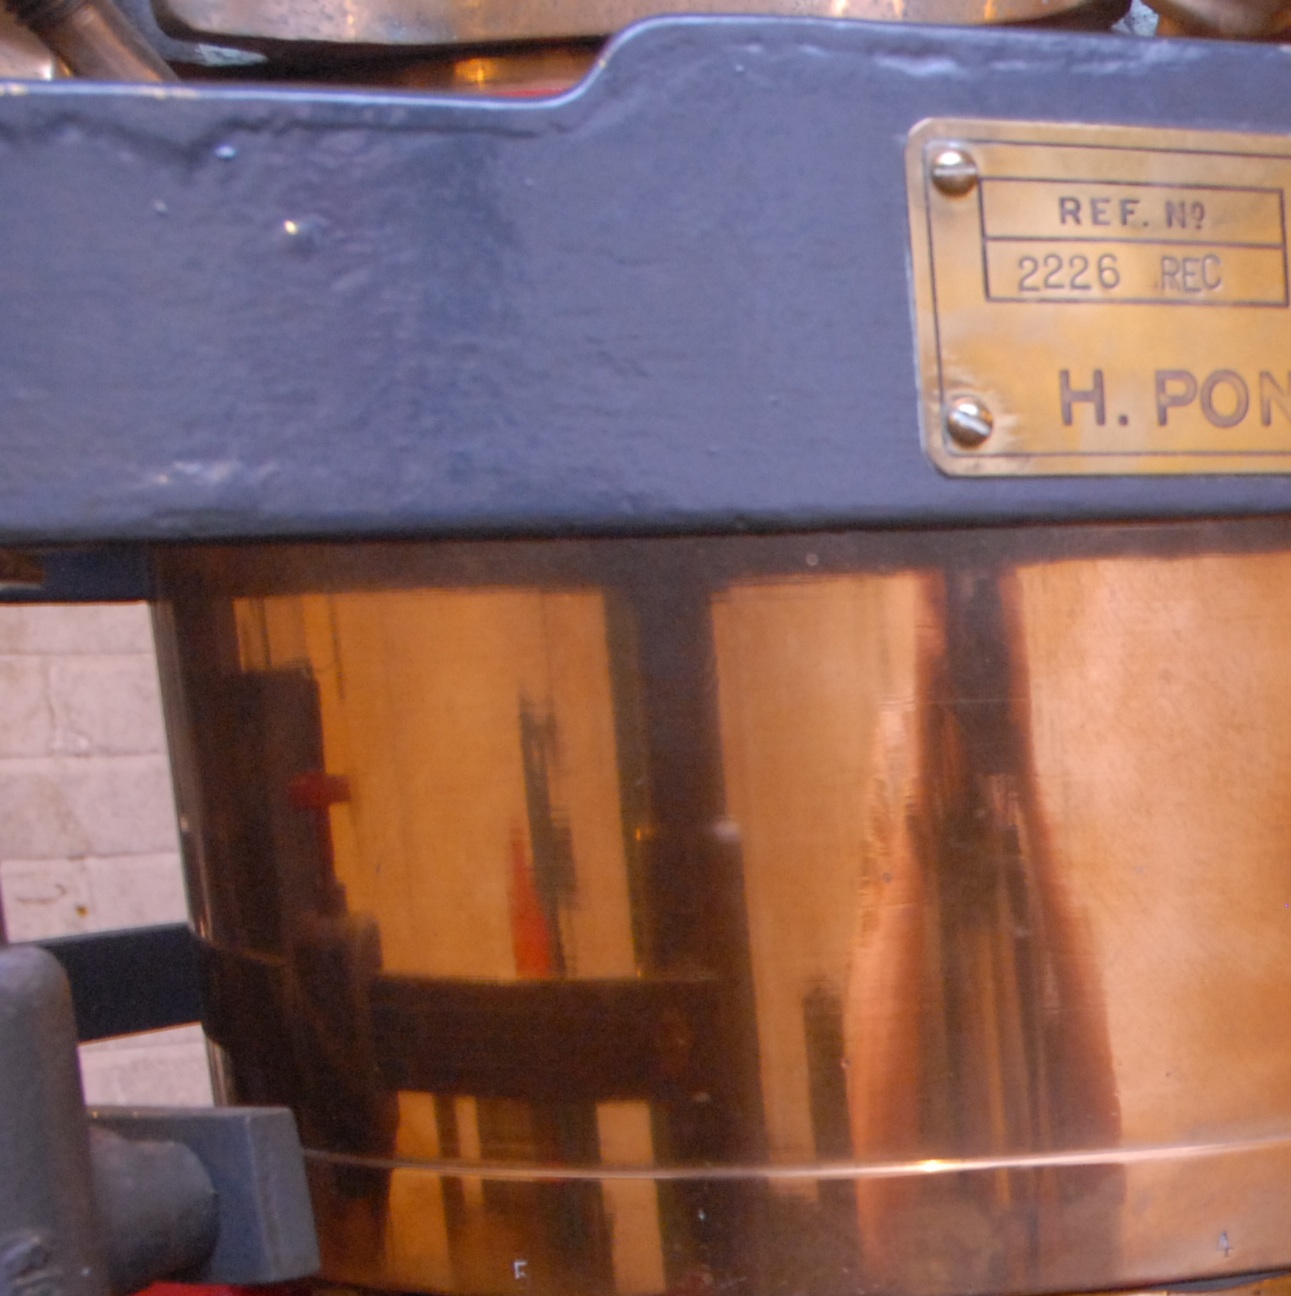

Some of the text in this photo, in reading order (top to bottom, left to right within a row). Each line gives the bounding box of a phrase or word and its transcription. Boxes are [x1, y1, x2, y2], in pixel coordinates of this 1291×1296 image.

[1058, 195, 1150, 228] REF.
[1017, 253, 1222, 294] 2226 REC
[1058, 368, 1130, 427] H.
